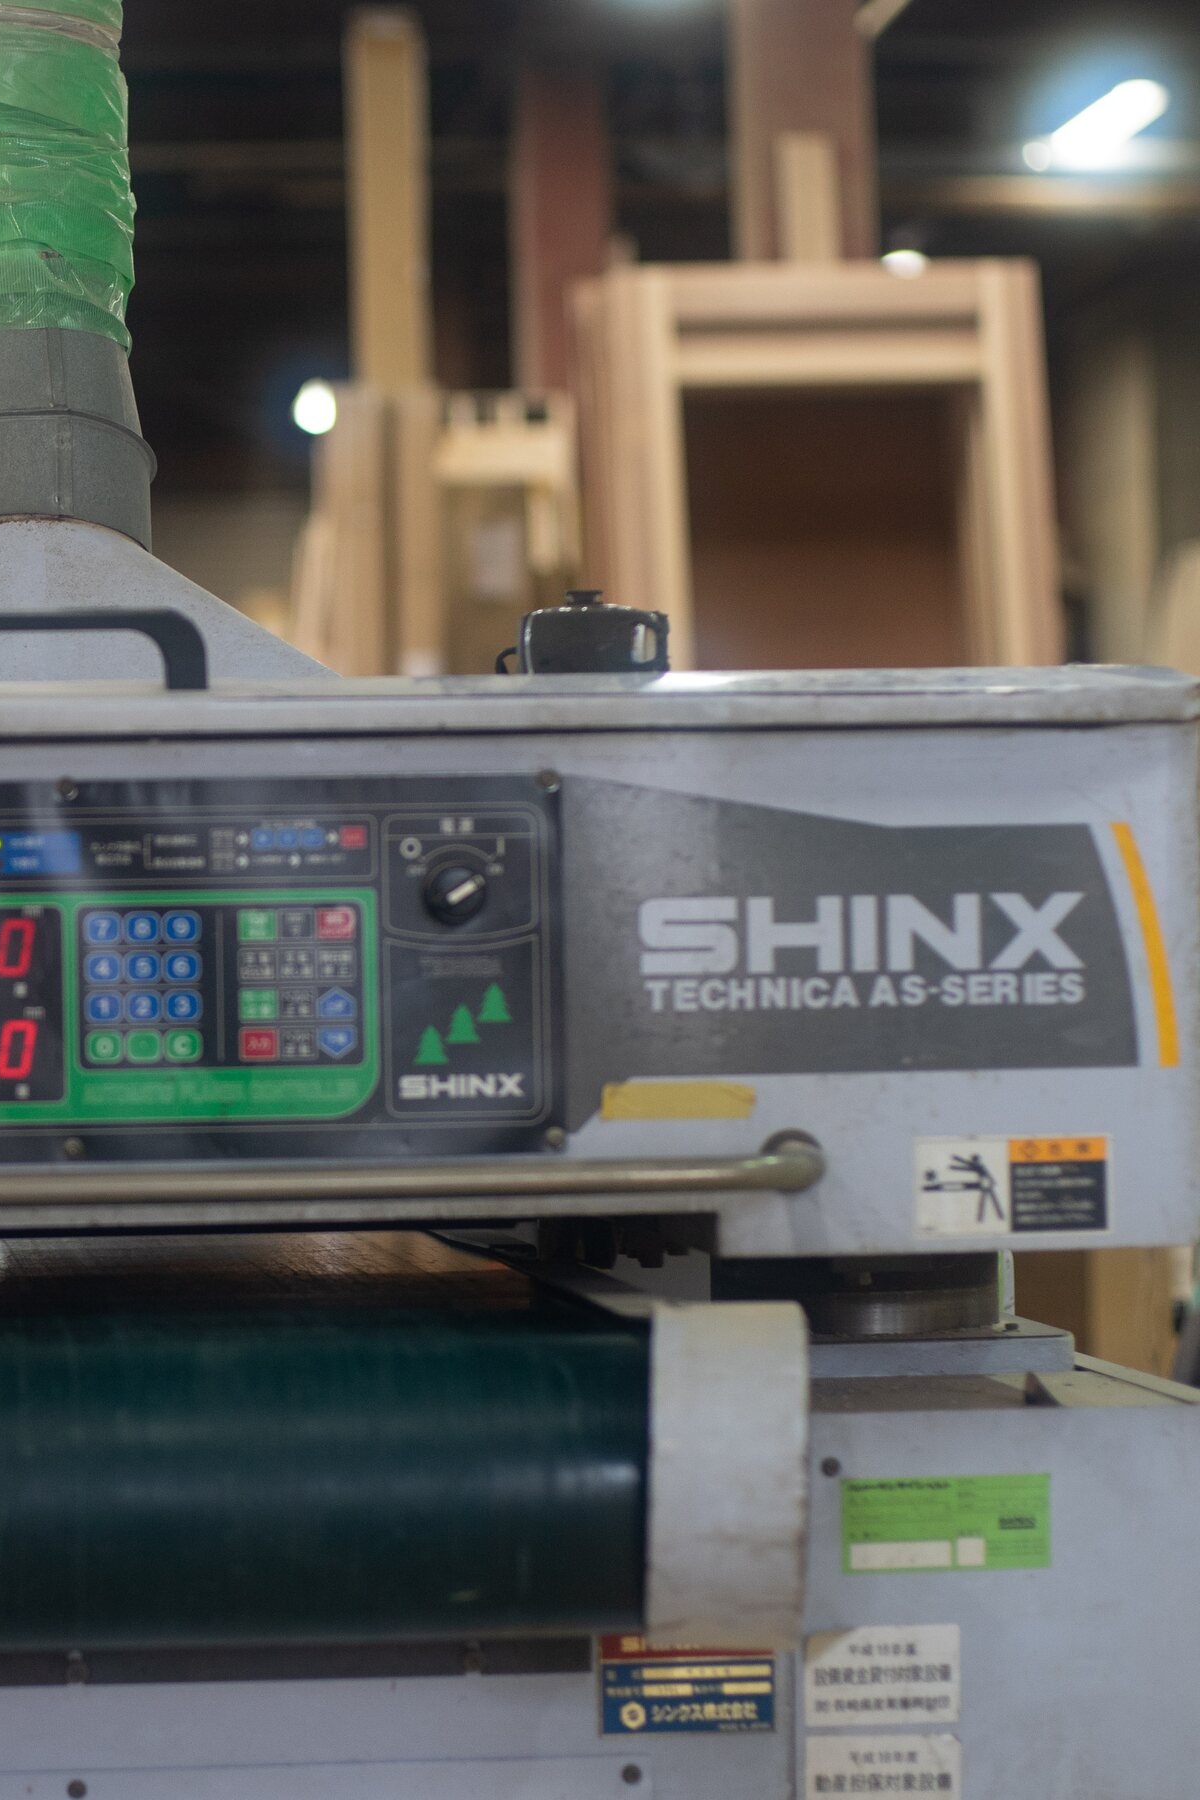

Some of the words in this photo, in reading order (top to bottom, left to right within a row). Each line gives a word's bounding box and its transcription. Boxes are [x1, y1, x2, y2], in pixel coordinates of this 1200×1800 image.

[96, 918, 111, 937] 7
[639, 892, 1085, 974] SHINX
[645, 977, 860, 1012] TECHNICA
[869, 974, 1085, 1006] AS-SERIES
[399, 1073, 524, 1100] SHINX
